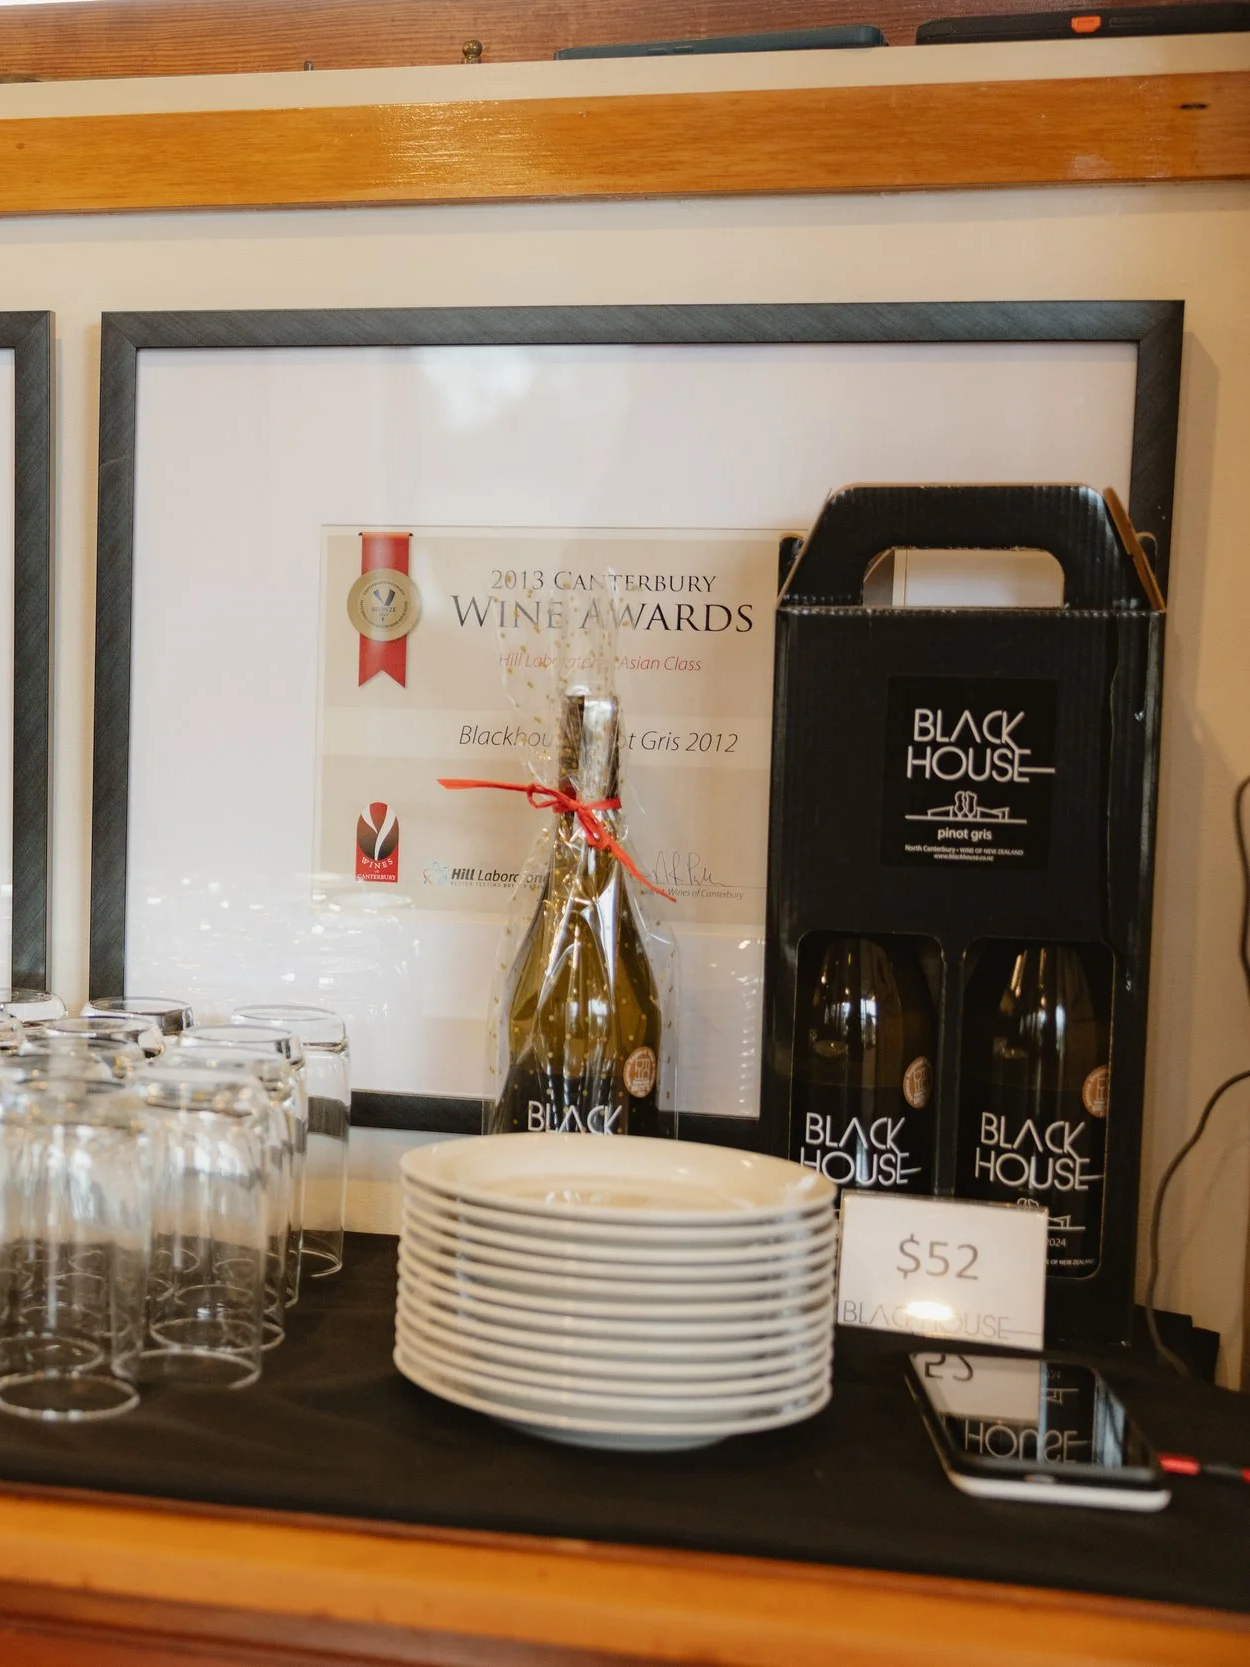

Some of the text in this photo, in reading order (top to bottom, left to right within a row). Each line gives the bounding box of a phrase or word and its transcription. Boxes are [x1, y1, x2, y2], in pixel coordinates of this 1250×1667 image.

[490, 570, 717, 593] 2013 CANTERBURY
[451, 594, 754, 633] WINE AWARDS
[618, 655, 659, 671] Asian
[662, 656, 702, 672] Class
[641, 731, 680, 751] Gris
[685, 732, 738, 753] 2012
[914, 708, 1025, 746] BLACK
[906, 745, 1056, 783] HOUSE
[937, 827, 993, 842] pinot gris
[357, 873, 397, 881] CANTERBURY
[361, 856, 394, 870] WINES
[451, 868, 476, 881] Hill
[668, 888, 692, 897] Wines
[692, 888, 700, 898] of
[701, 890, 744, 900] Canterbury
[527, 1100, 623, 1136] BLACK
[805, 1111, 906, 1150] BLACK
[980, 1111, 1086, 1154] BLACK
[800, 1146, 922, 1187] HOUSE
[974, 1147, 1105, 1191] HOUSE
[896, 1233, 979, 1281] $52
